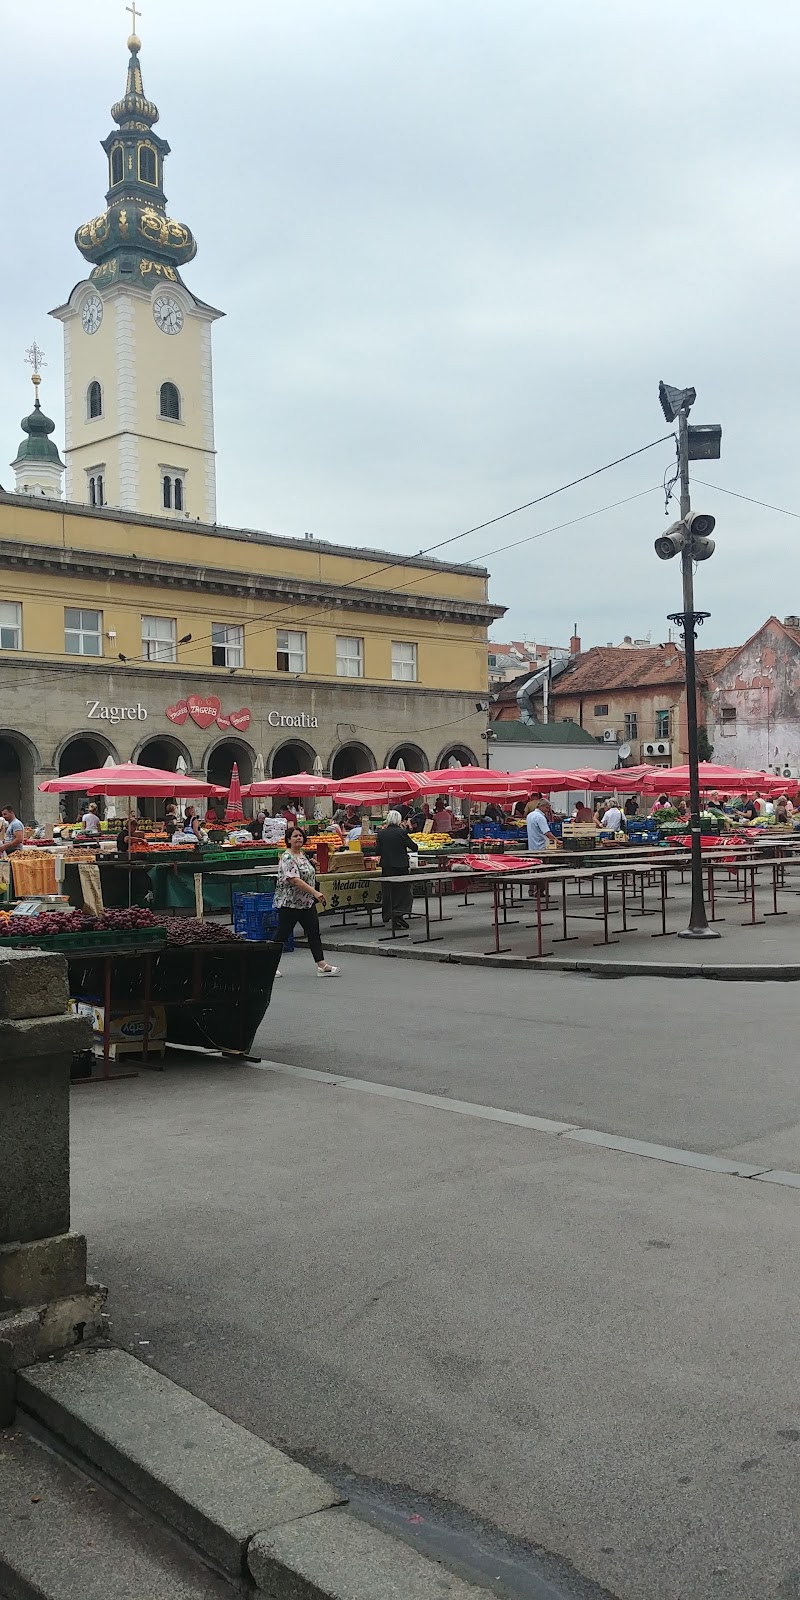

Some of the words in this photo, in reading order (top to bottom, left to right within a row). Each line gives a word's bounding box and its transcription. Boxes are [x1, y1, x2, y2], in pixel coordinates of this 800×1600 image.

[86, 700, 148, 725] Zagreb
[190, 705, 218, 717] ZAGREB
[267, 710, 319, 728] Croatia
